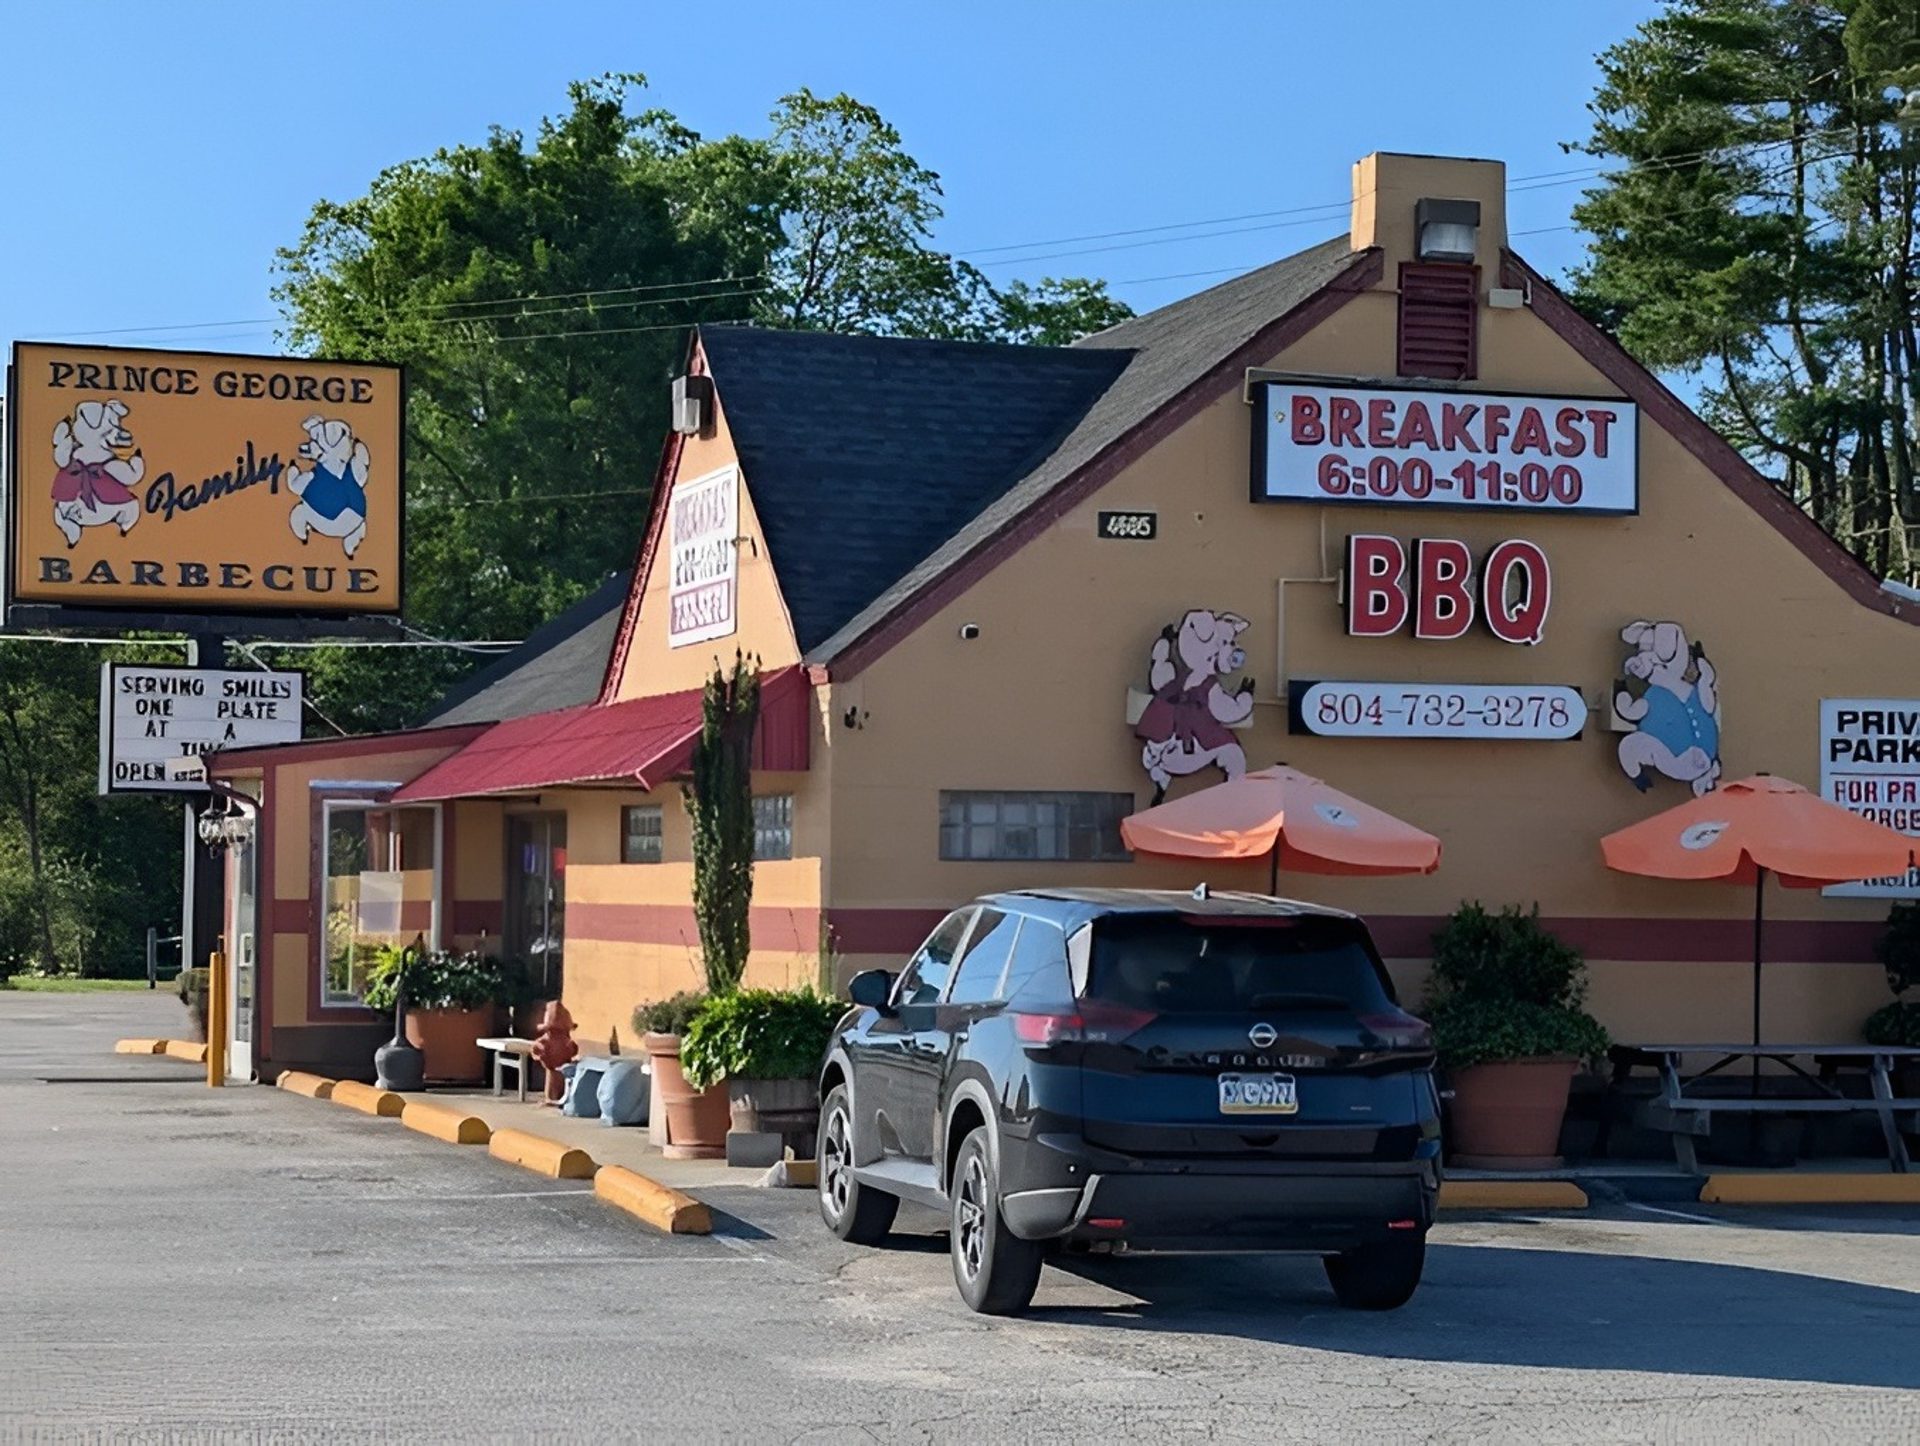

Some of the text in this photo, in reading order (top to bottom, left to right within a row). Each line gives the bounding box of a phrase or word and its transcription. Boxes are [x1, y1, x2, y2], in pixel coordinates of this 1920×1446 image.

[47, 361, 374, 403] PRINCE GEORGE
[1290, 394, 1617, 459] BREAKFAST
[145, 440, 285, 522] Family
[1317, 454, 1583, 504] 6:00-11:00
[39, 557, 380, 594] BARBECUE
[1344, 534, 1552, 646] BBQ
[120, 675, 291, 699] SERVING SMILES
[135, 698, 278, 720] ONE PLATE
[1317, 693, 1570, 727] 804-732-3278
[144, 719, 236, 740] AT A
[1834, 780, 1878, 803] FOR
